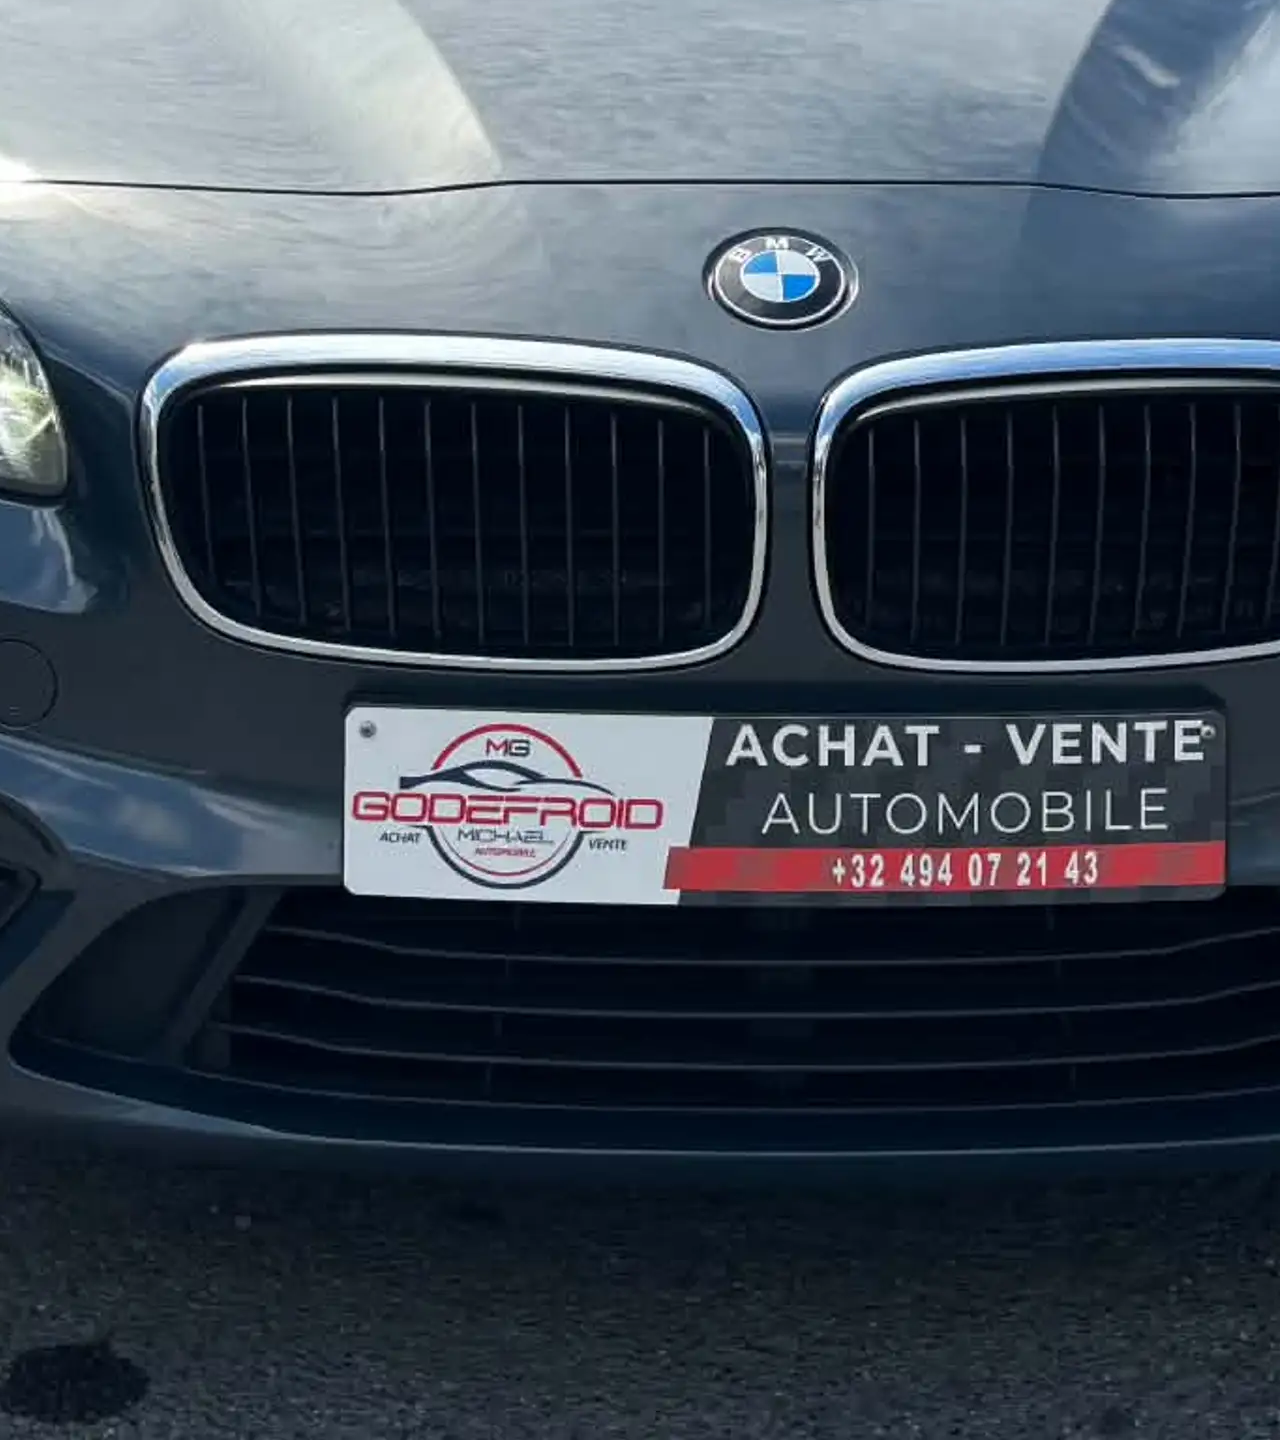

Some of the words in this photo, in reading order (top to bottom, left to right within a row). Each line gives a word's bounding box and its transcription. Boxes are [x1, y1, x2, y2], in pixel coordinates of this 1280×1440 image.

[728, 236, 834, 262] BMW
[485, 738, 531, 757] MG
[725, 723, 941, 767] ACHAT
[1005, 720, 1205, 765] VENTE
[352, 791, 664, 830] GODEFROID
[761, 788, 1169, 835] AUTOMOBILE
[379, 831, 421, 843] ACHAT
[588, 838, 629, 851] VENTE
[832, 854, 885, 888] +32
[900, 853, 952, 887] 494
[967, 852, 1002, 886] 07
[1016, 851, 1047, 886] 21
[1064, 850, 1099, 885] 43
